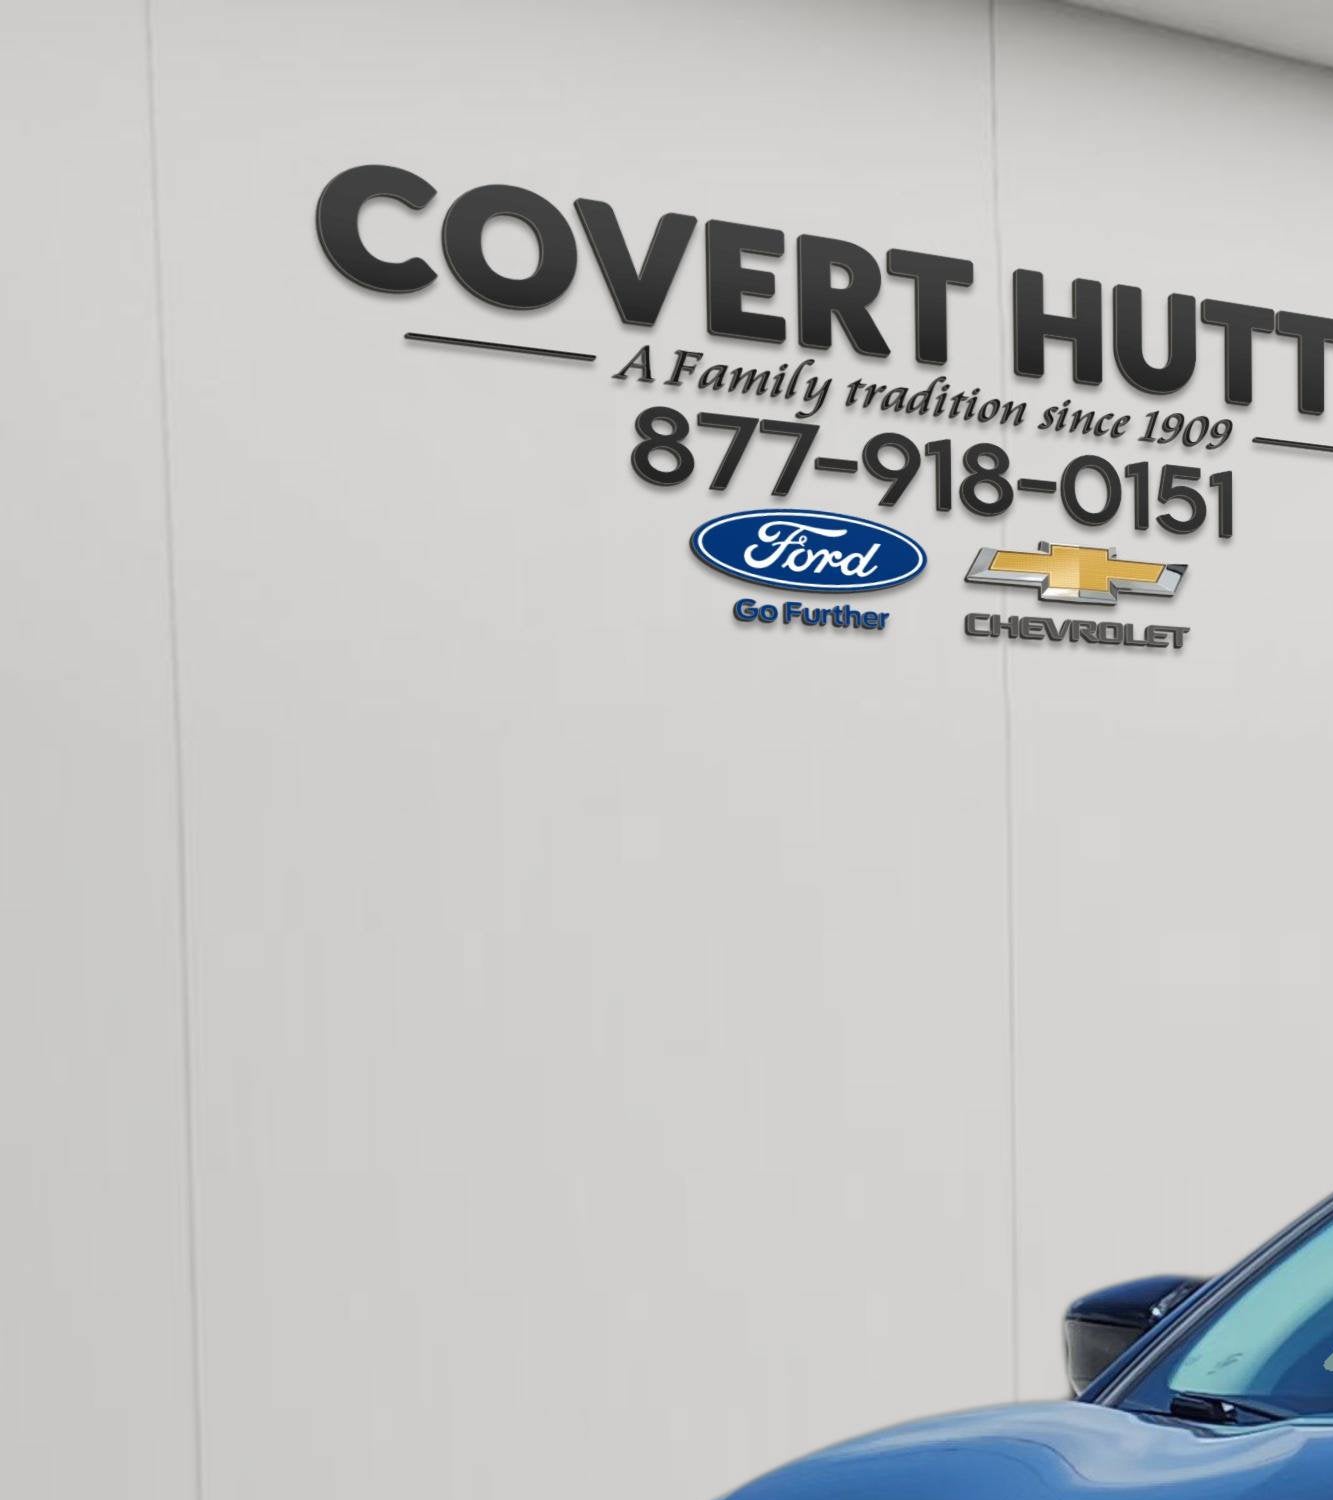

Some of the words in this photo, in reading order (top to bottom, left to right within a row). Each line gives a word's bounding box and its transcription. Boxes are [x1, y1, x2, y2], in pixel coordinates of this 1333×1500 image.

[315, 164, 974, 368] COVERT
[611, 343, 656, 385] A
[662, 348, 834, 421] Family
[845, 376, 1028, 428] tradition
[1037, 399, 1131, 440] since
[1138, 409, 1235, 452] 1909
[630, 405, 1234, 541] 877-918-0151
[742, 519, 882, 578] Ford
[732, 597, 779, 626] Go
[782, 600, 891, 631] Further
[963, 611, 1192, 650] CHEVROLET
